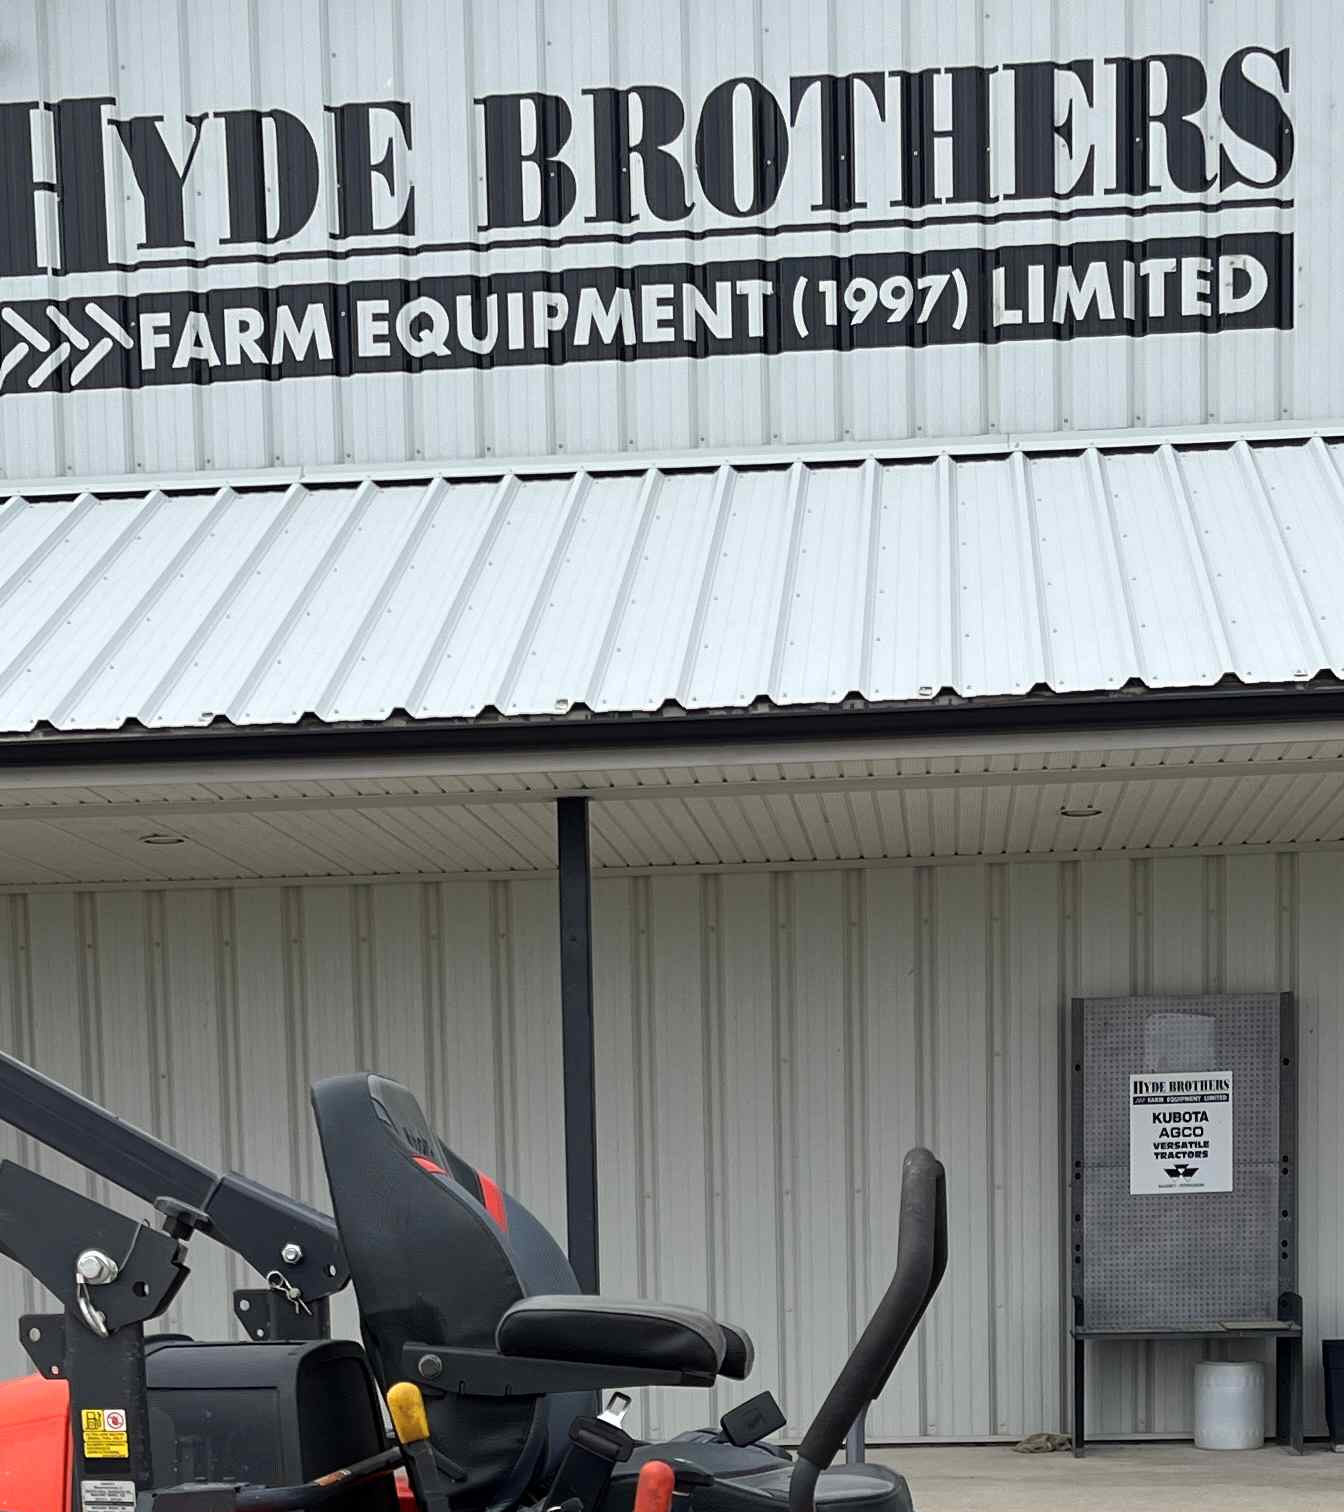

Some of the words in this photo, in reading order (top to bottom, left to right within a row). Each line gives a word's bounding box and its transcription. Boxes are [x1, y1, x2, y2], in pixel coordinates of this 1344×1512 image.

[473, 46, 1295, 232] BROTHERS
[139, 302, 334, 370] FARM
[357, 279, 774, 358] EQUIPMENT
[792, 266, 969, 340] (1997)
[992, 254, 1269, 328] LIMITED
[1133, 1081, 1166, 1094] HYDE
[1169, 1079, 1229, 1092] BROTHERS
[1152, 1111, 1209, 1123] KUBOTA
[1159, 1126, 1204, 1138] AGCO
[1153, 1141, 1209, 1149] VERSATILE
[1154, 1151, 1208, 1159] TRACTORS
